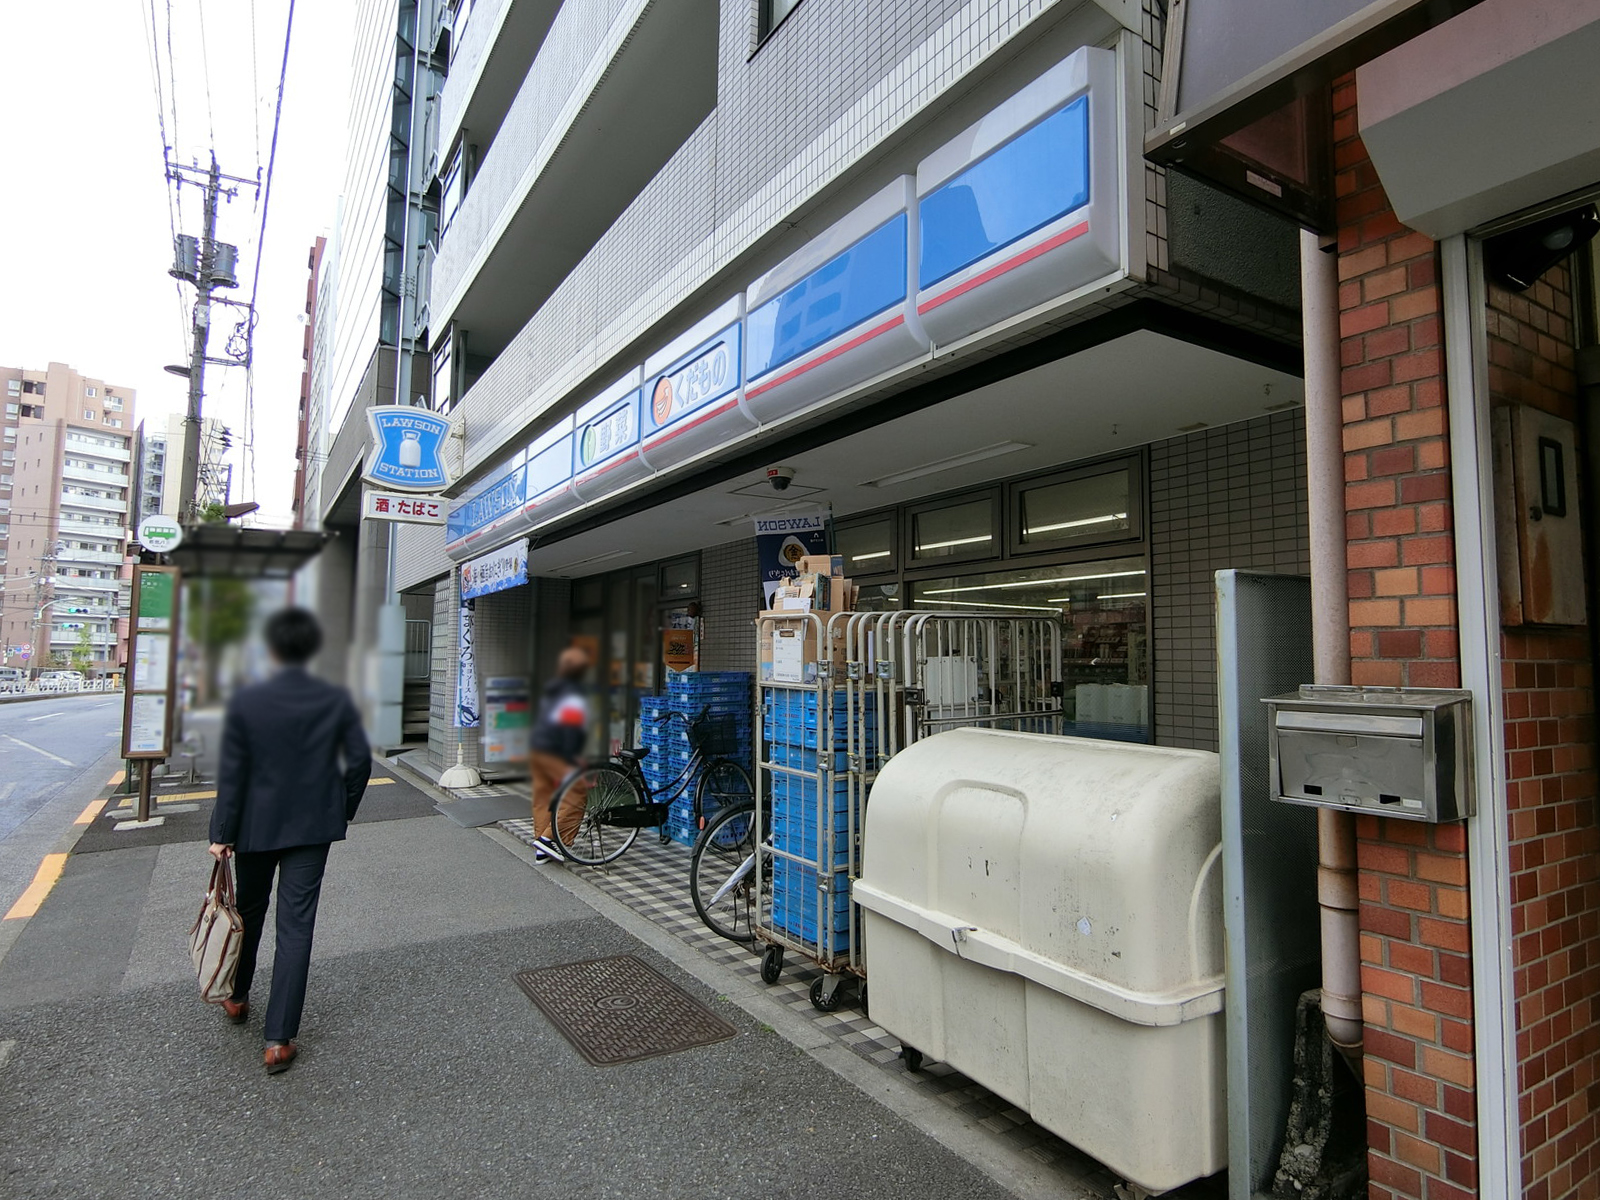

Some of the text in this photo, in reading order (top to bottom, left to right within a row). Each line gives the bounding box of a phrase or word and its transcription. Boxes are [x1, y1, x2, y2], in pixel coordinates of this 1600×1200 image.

[674, 349, 728, 408] くだもの
[382, 418, 441, 435] LAWSON
[380, 462, 439, 478] STATION
[375, 498, 439, 517] 酒・たばこ
